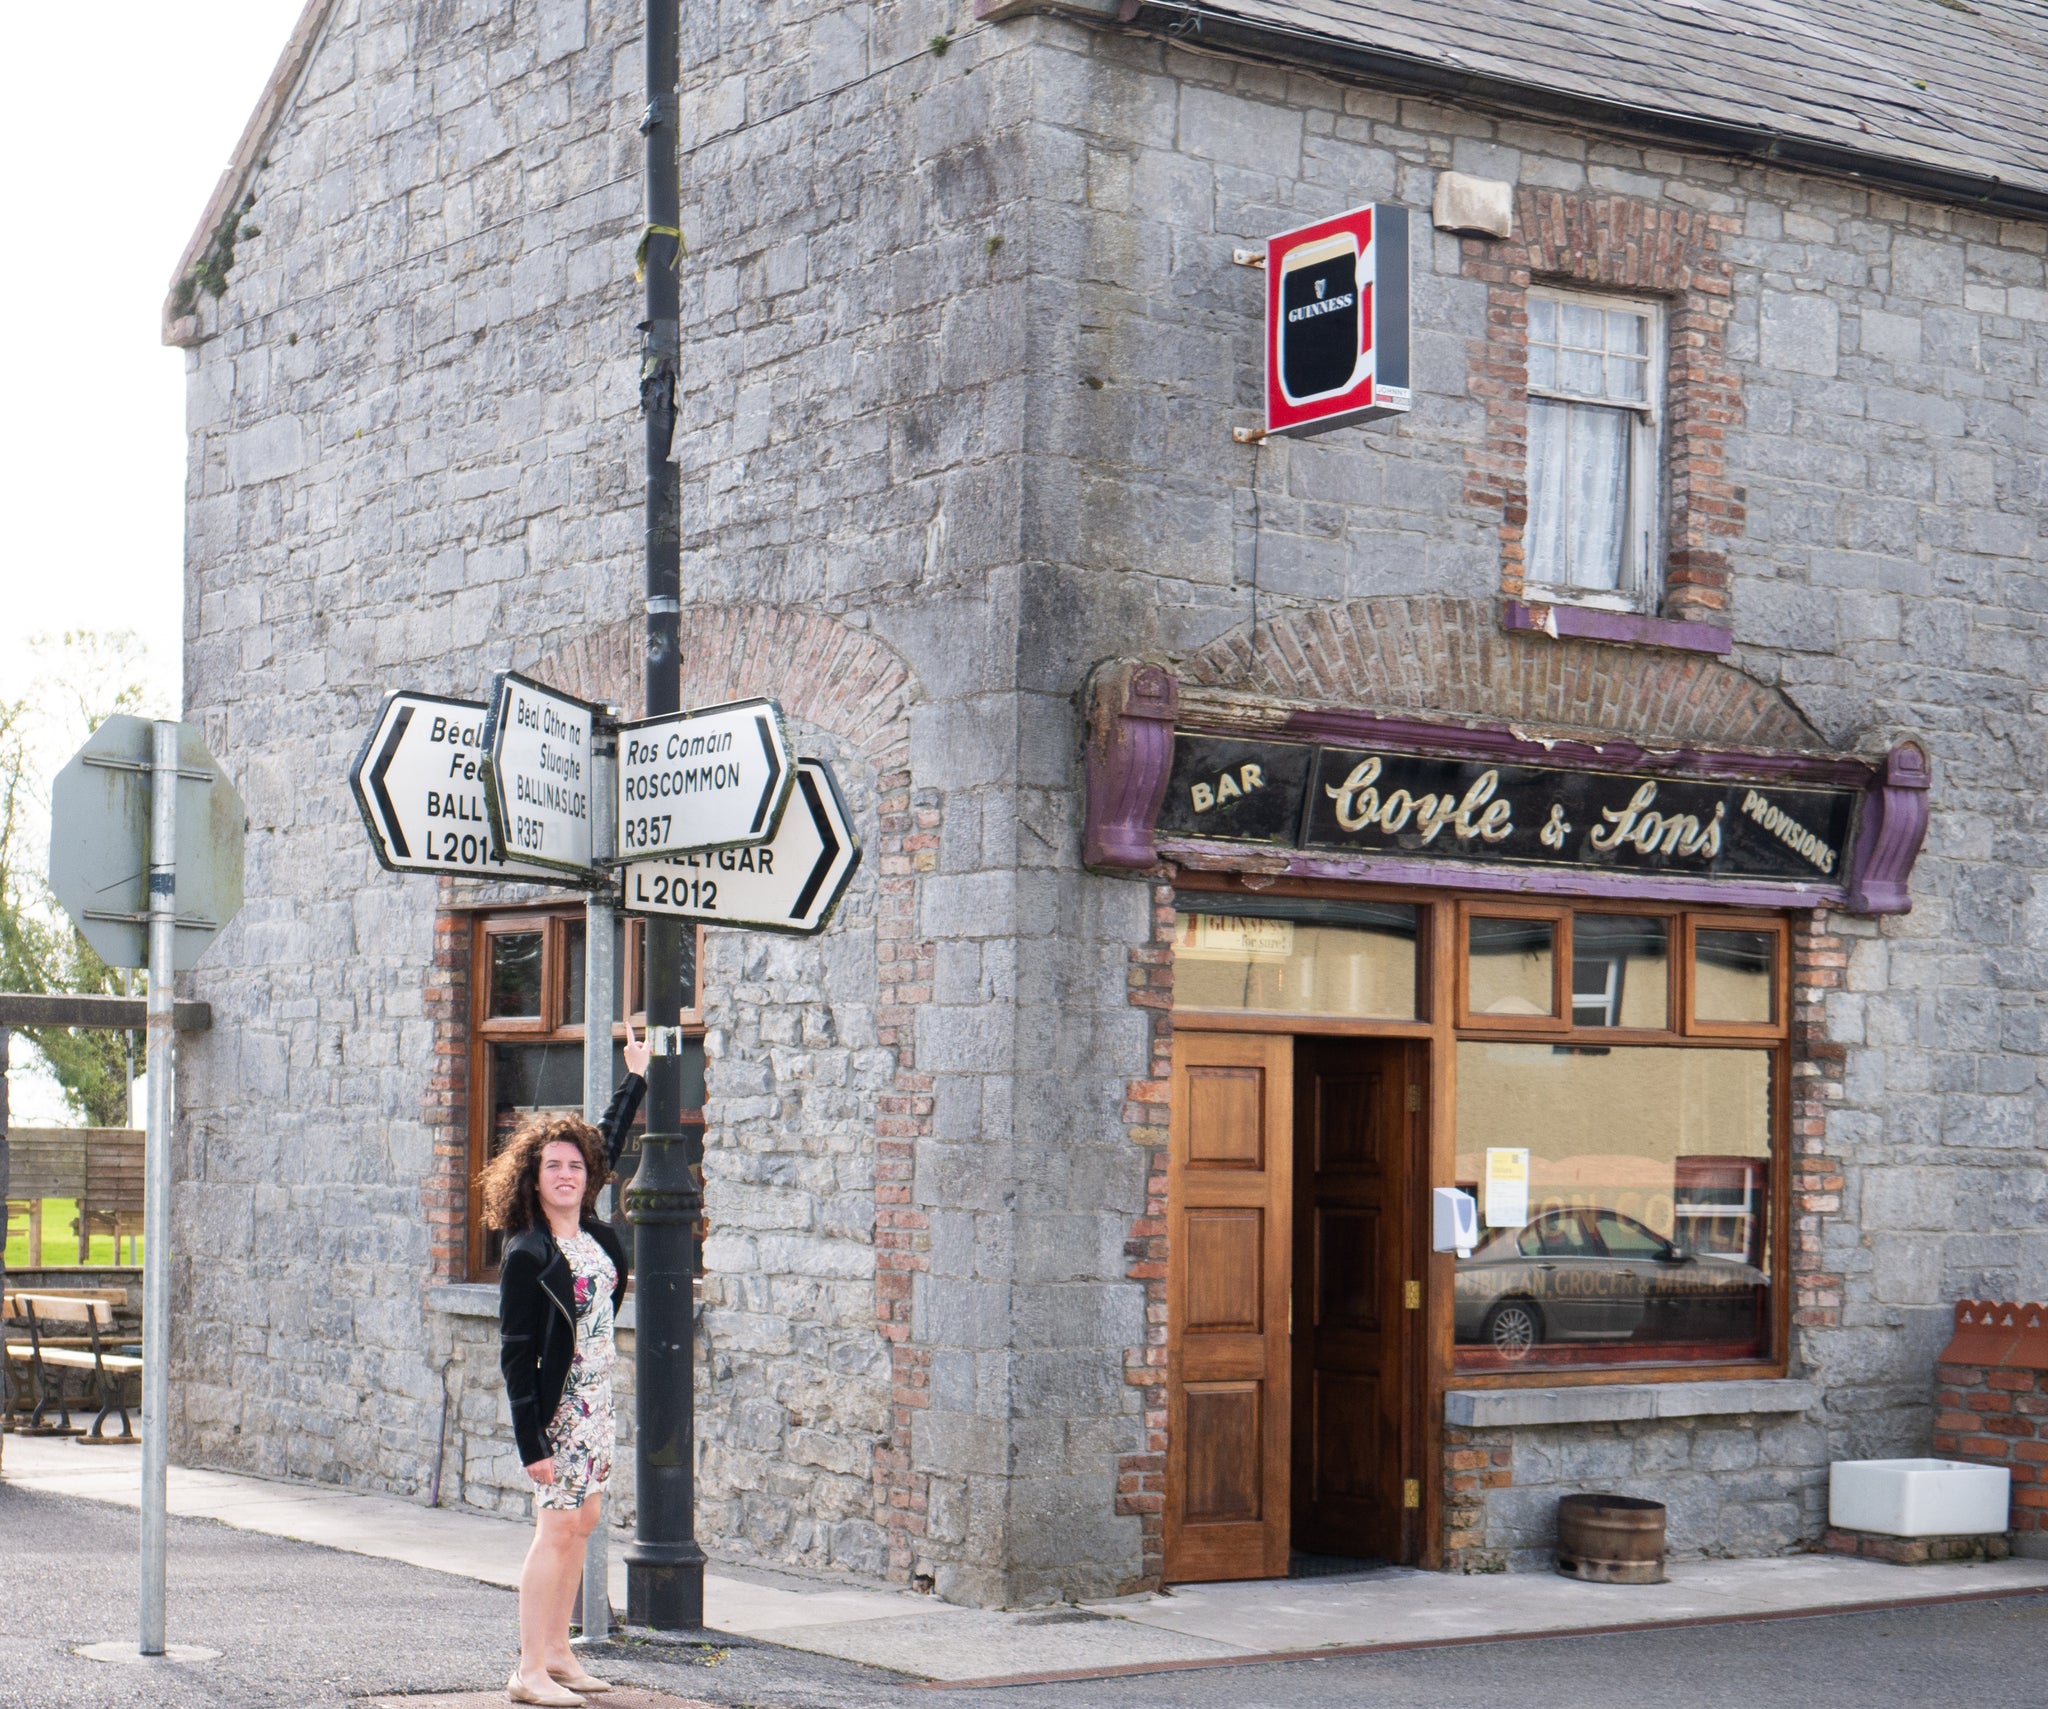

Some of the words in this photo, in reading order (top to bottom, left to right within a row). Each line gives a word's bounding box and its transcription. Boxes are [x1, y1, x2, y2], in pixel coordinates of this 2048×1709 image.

[1288, 293, 1353, 322] GUINNESS
[430, 716, 482, 748] Béal
[517, 698, 540, 731] Béal
[543, 701, 566, 740] Átha
[568, 725, 581, 746] na
[540, 742, 580, 782] Sluaighe
[626, 740, 659, 766] Ros
[667, 730, 733, 760] Comáin
[517, 774, 586, 819] BALLINASLOE
[625, 762, 740, 802] ROSCOMMON
[1190, 762, 1265, 813] BAR
[427, 791, 491, 823] BALL
[1325, 756, 1514, 849] Coyle
[1540, 803, 1572, 850] &
[517, 815, 544, 850] R357
[625, 815, 672, 848] R357
[1741, 788, 1838, 875] PROVISIONS
[636, 873, 718, 910] L2012
